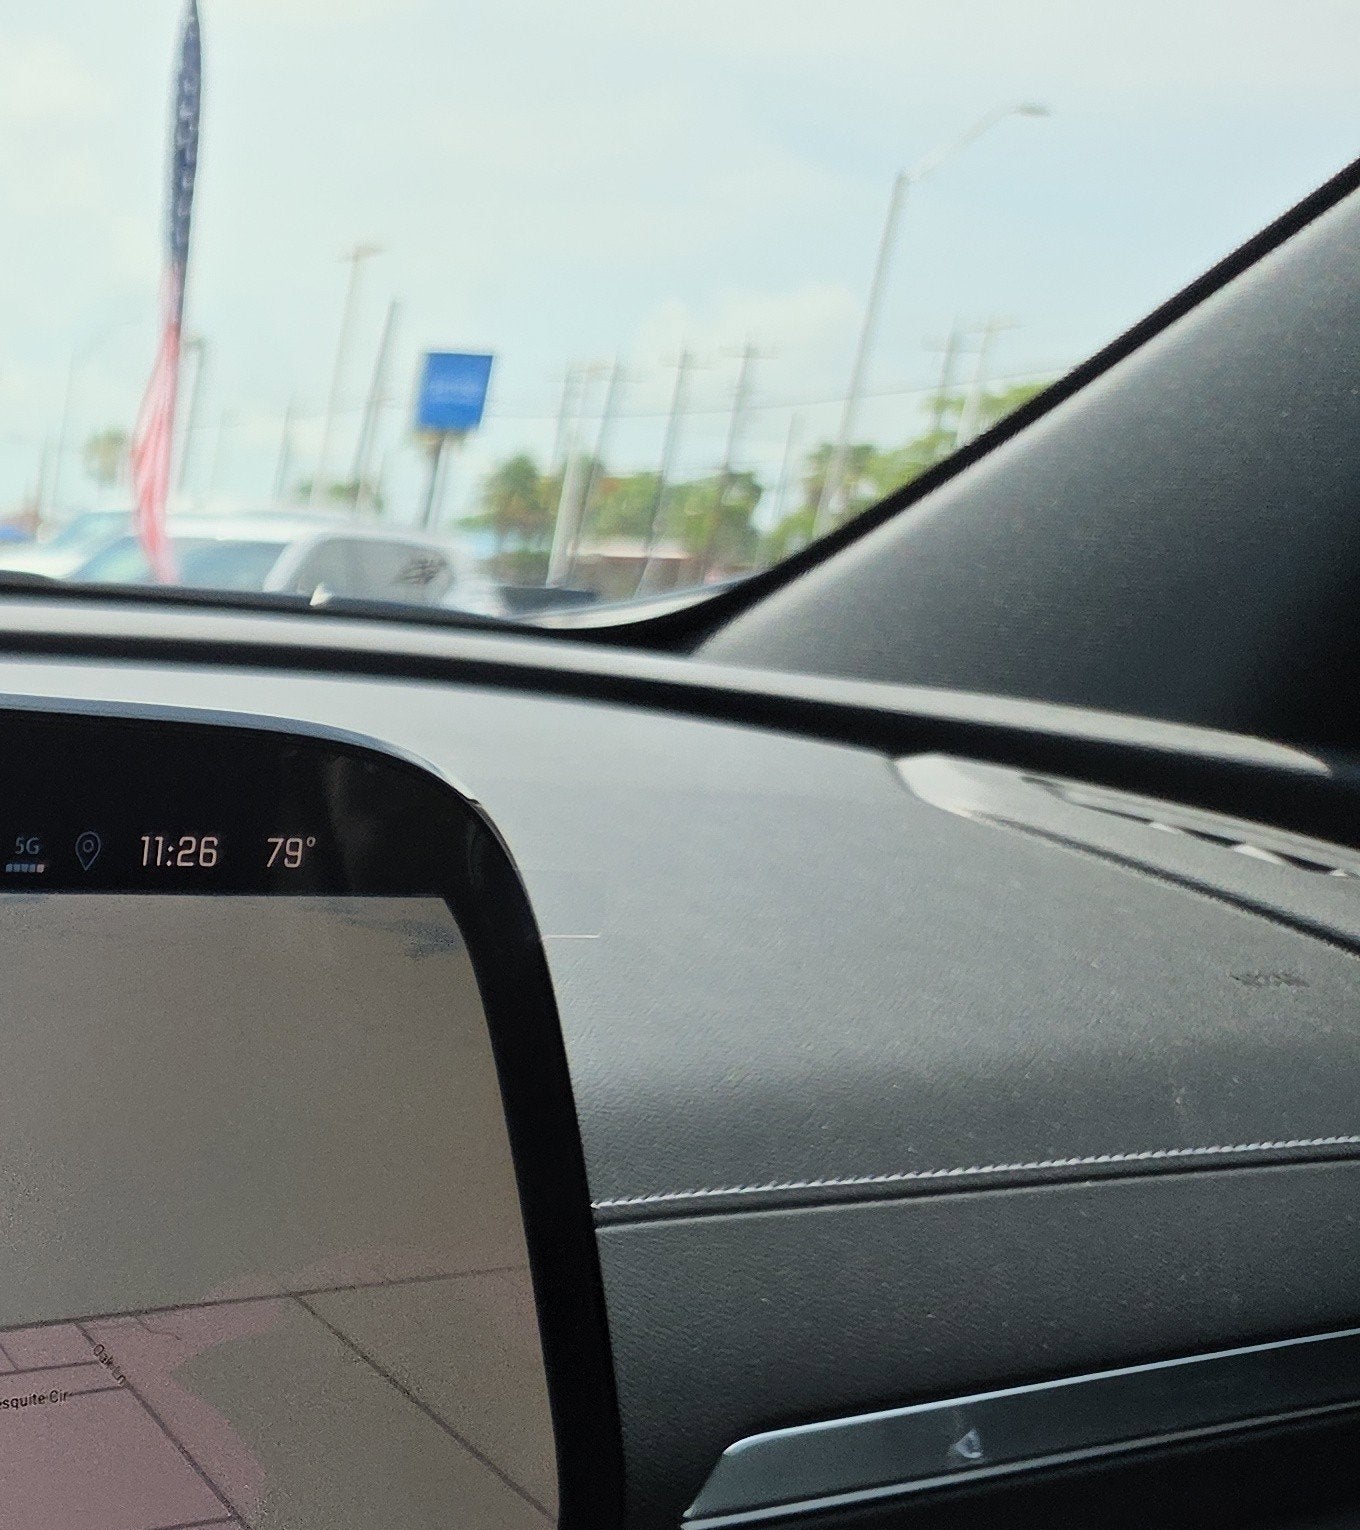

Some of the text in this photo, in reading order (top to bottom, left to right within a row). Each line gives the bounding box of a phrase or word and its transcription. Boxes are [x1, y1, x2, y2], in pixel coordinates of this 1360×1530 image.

[14, 835, 40, 855] 5G
[140, 835, 317, 868] 11:26 79°
[49, 1389, 69, 1404] Cir
